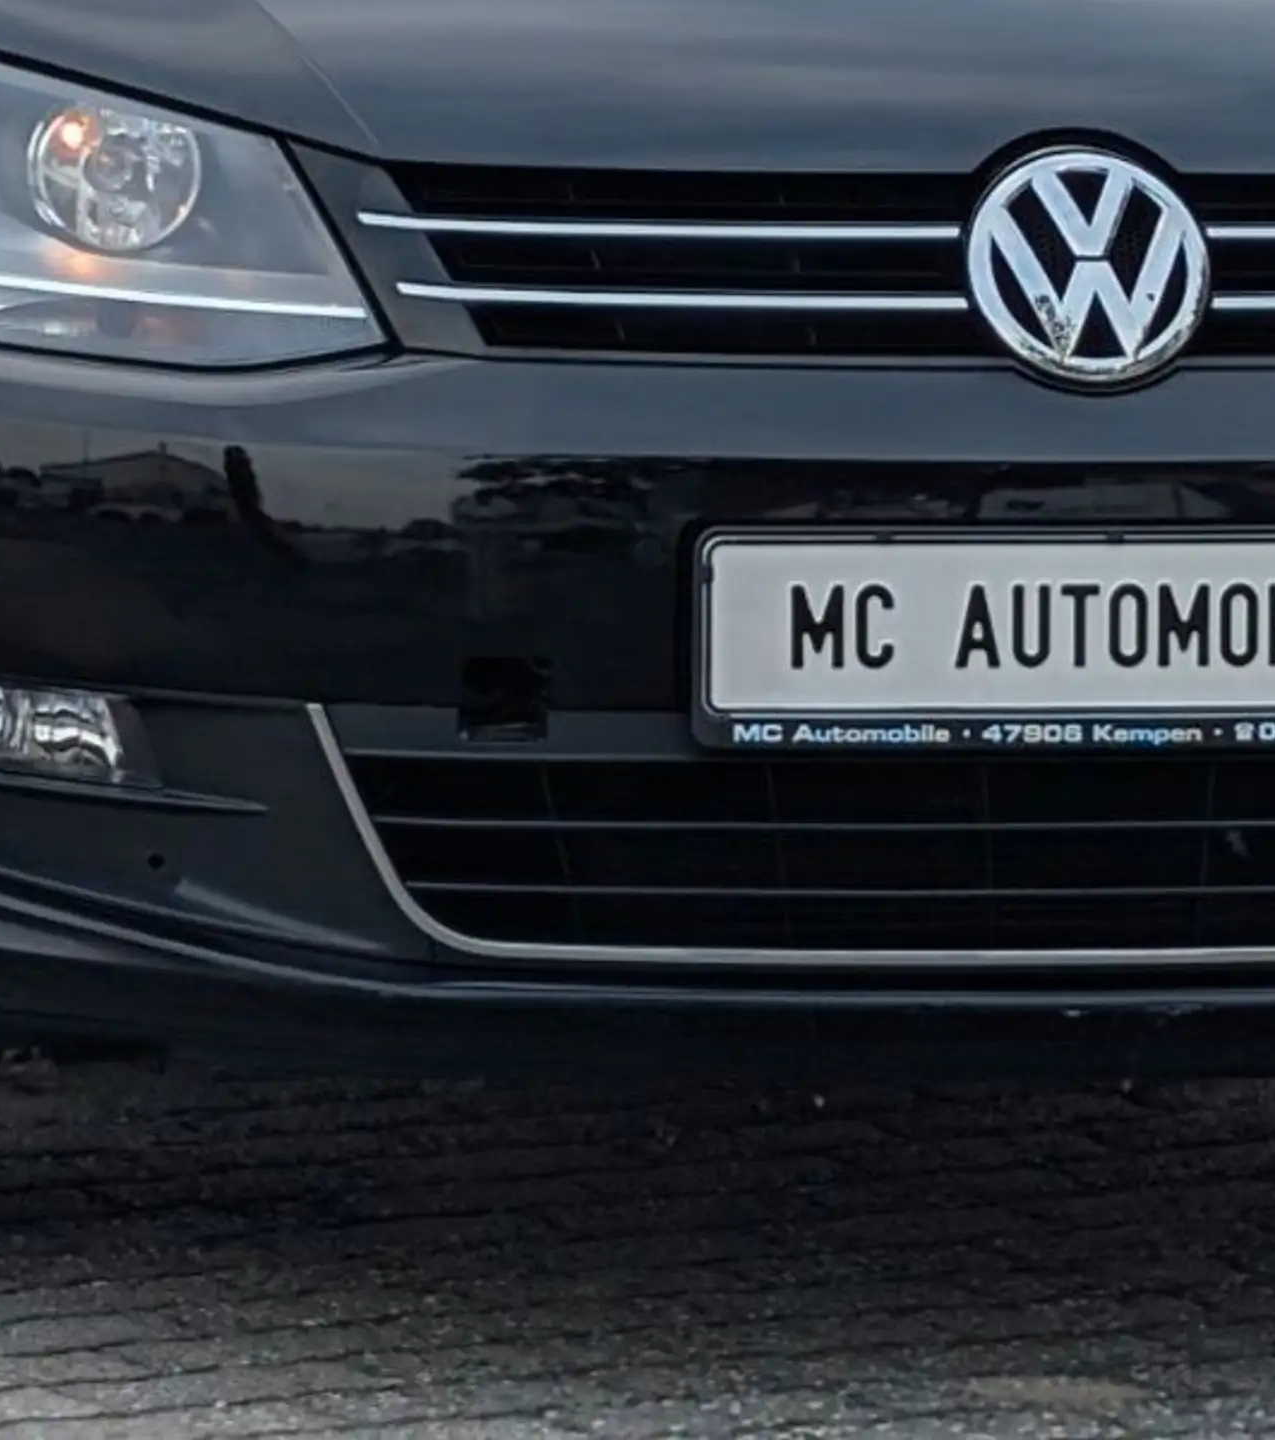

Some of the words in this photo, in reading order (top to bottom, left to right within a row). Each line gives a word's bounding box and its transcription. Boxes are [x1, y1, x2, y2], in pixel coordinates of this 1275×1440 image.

[789, 583, 895, 670] MC
[732, 723, 784, 743] MC
[791, 723, 951, 743] Automobile
[981, 723, 1083, 744] 47906
[1092, 723, 1203, 746] Kempen
